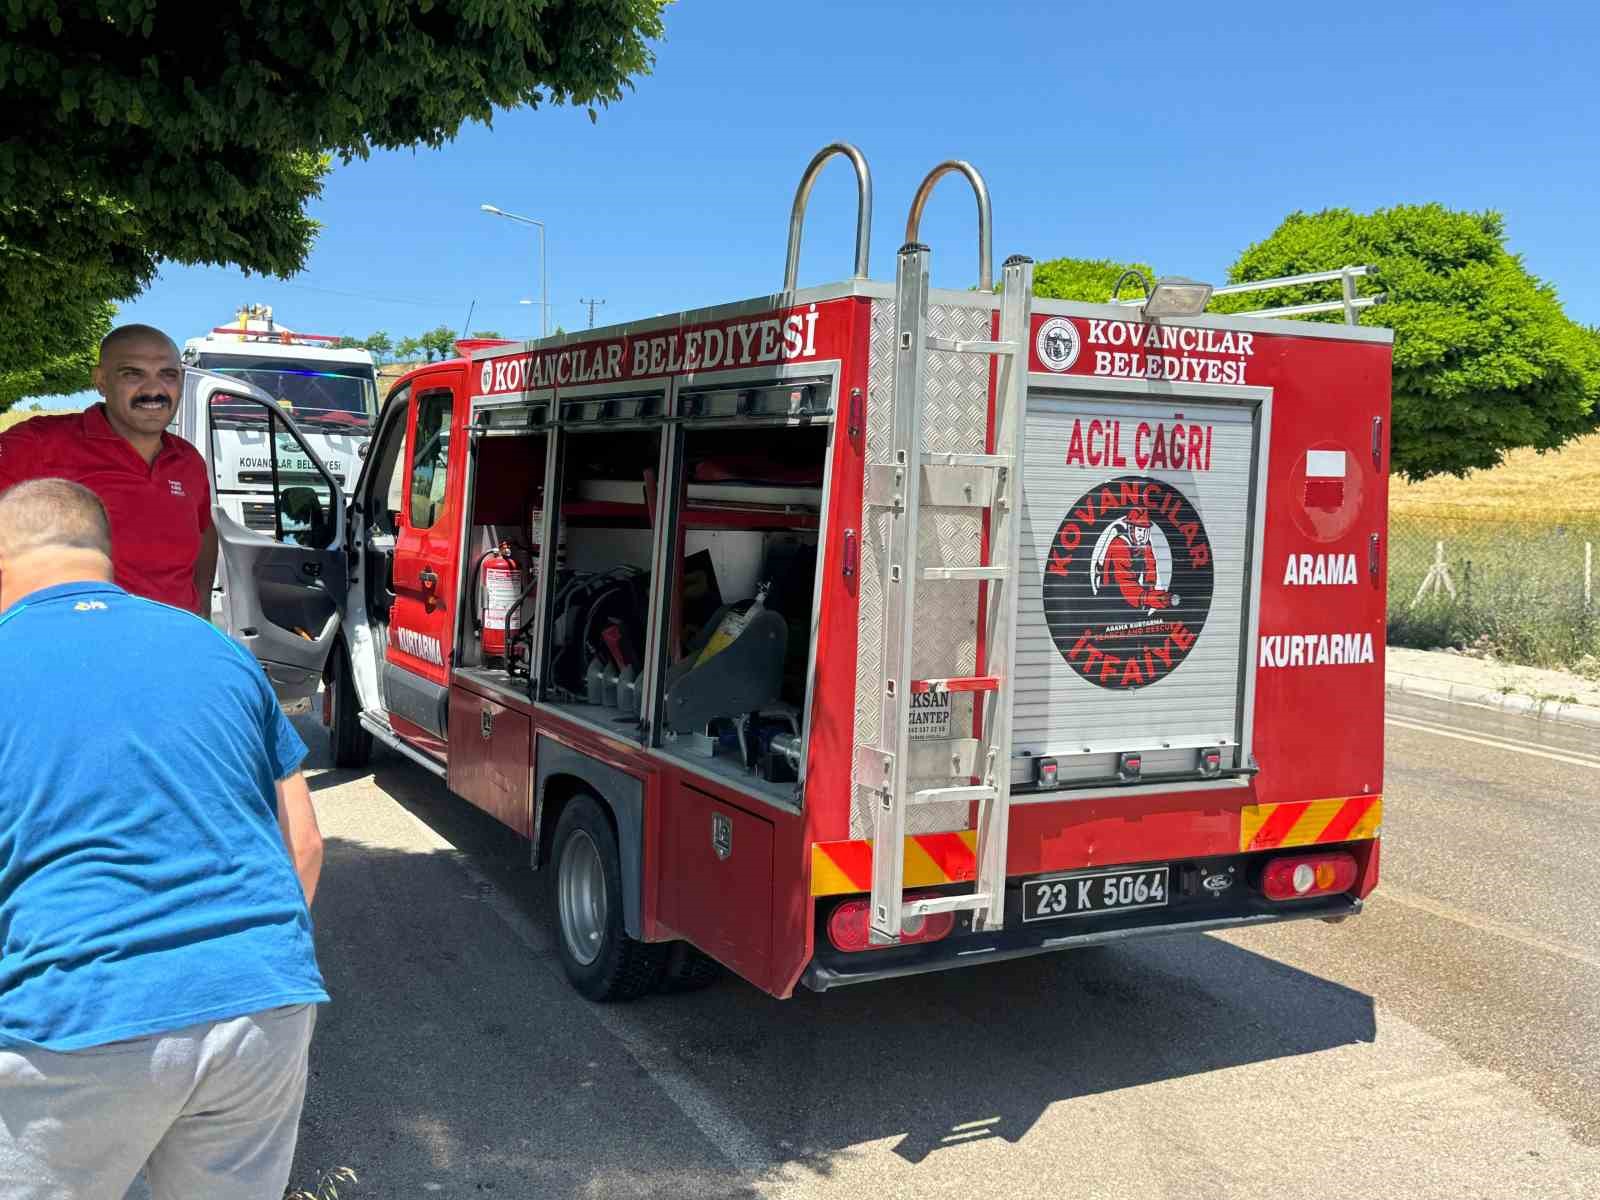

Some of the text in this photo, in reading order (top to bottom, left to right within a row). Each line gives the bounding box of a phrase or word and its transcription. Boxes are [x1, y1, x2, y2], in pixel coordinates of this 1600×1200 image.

[1088, 319, 1254, 355] KOVANCILAR
[494, 344, 624, 392] KOVANCILAR
[1094, 351, 1248, 385] BELEDİYESİ
[1135, 413, 1214, 470] CAĞRI
[1049, 480, 1209, 577] KOVANCILAR
[1283, 554, 1359, 586] ARAMA
[398, 626, 444, 666] KURTARMA
[1260, 633, 1375, 668] KURTARMA
[909, 691, 949, 708] KSAN
[1036, 873, 1164, 915] 23 K 5064
